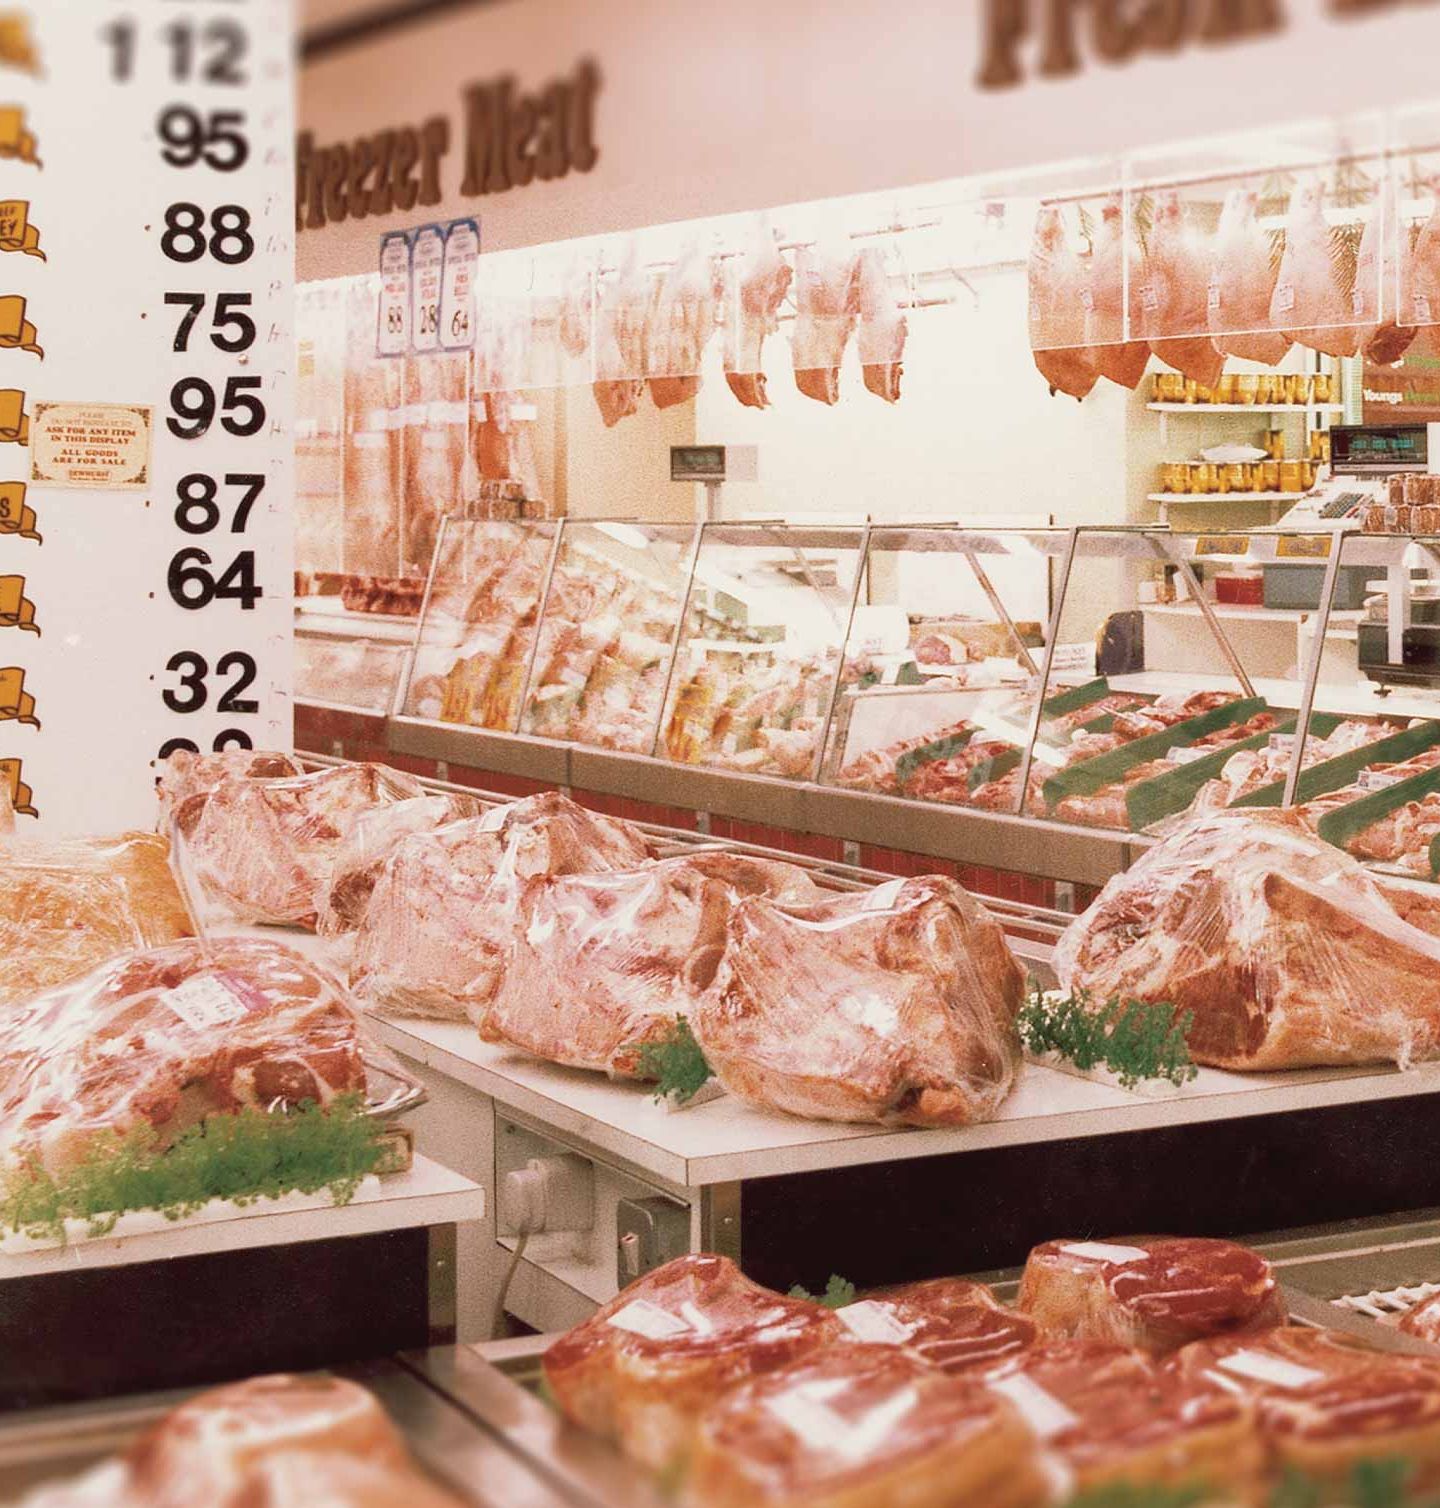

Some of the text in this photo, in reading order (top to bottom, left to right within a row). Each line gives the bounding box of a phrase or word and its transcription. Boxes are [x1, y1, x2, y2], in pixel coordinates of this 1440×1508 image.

[156, 103, 250, 173] 95
[460, 54, 604, 198] Meat
[161, 202, 254, 265] 88
[164, 292, 257, 353] 75
[387, 306, 403, 334] 88
[420, 304, 437, 334] 28
[451, 309, 469, 337] 64
[112, 429, 136, 437] ITEM
[166, 375, 266, 440] 95
[61, 448, 118, 457] ALL GOODS
[90, 436, 129, 444] DISPLAY
[174, 472, 266, 535] 87
[167, 546, 263, 610] 64
[162, 650, 259, 714] 32
